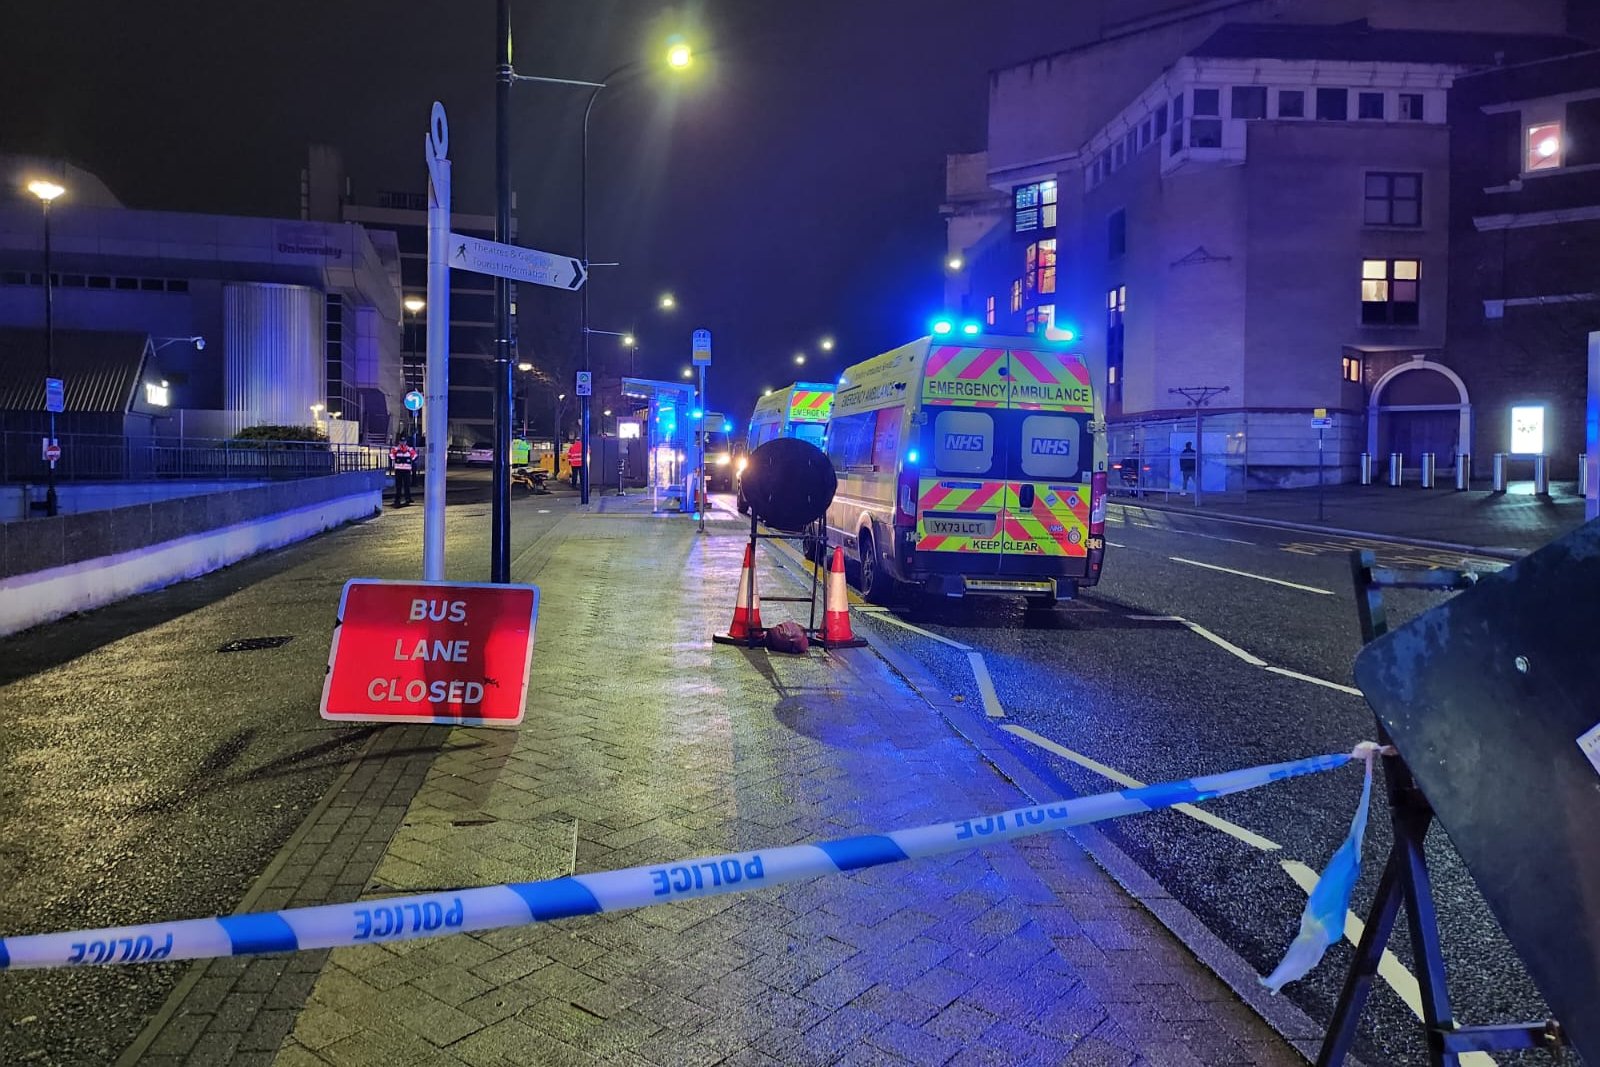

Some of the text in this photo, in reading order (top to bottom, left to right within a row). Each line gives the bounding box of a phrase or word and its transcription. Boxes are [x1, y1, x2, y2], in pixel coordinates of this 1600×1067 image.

[473, 243, 508, 258] Theatres
[473, 257, 499, 270] Tourist
[929, 381, 1089, 402] EMERGENCY AMBULANCE
[792, 404, 829, 420] EMERGENC
[945, 434, 983, 451] NHS
[1032, 438, 1069, 455] NHS
[934, 521, 980, 534] YX73 LCT
[972, 540, 1038, 551] KEEP CLEAR
[410, 598, 466, 622] BUS
[394, 638, 470, 662] LANE
[367, 677, 485, 704] CLOSED
[649, 856, 764, 896] POLICE
[353, 898, 464, 940] POLICE
[68, 933, 173, 964] POLICE
